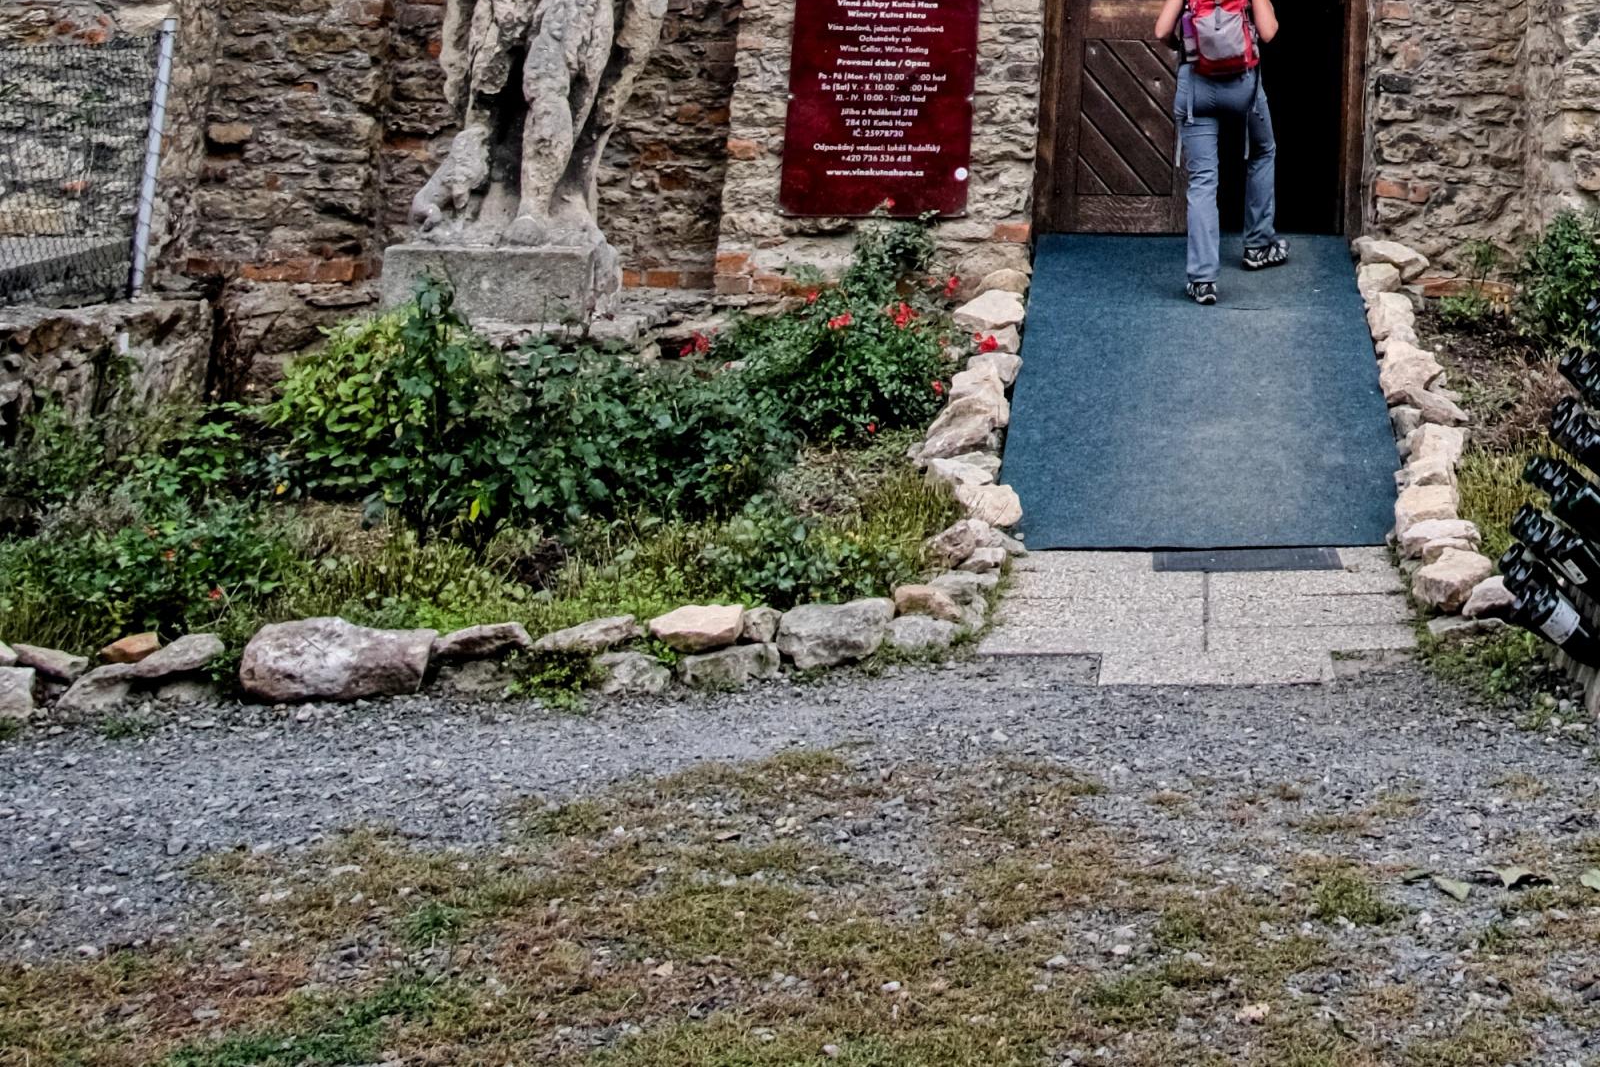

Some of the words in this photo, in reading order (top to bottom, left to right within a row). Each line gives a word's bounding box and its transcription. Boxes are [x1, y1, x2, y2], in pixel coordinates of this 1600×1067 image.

[837, 0, 860, 7] Vinné
[863, 0, 890, 9] sklepy
[892, 0, 916, 8] Kutná
[848, 10, 877, 19] Winery
[905, 46, 928, 54] Tasting
[875, 59, 896, 67] doba
[869, 73, 881, 81] Fri)
[868, 108, 901, 116] Poděbrad
[813, 143, 854, 152] Odpovědný
